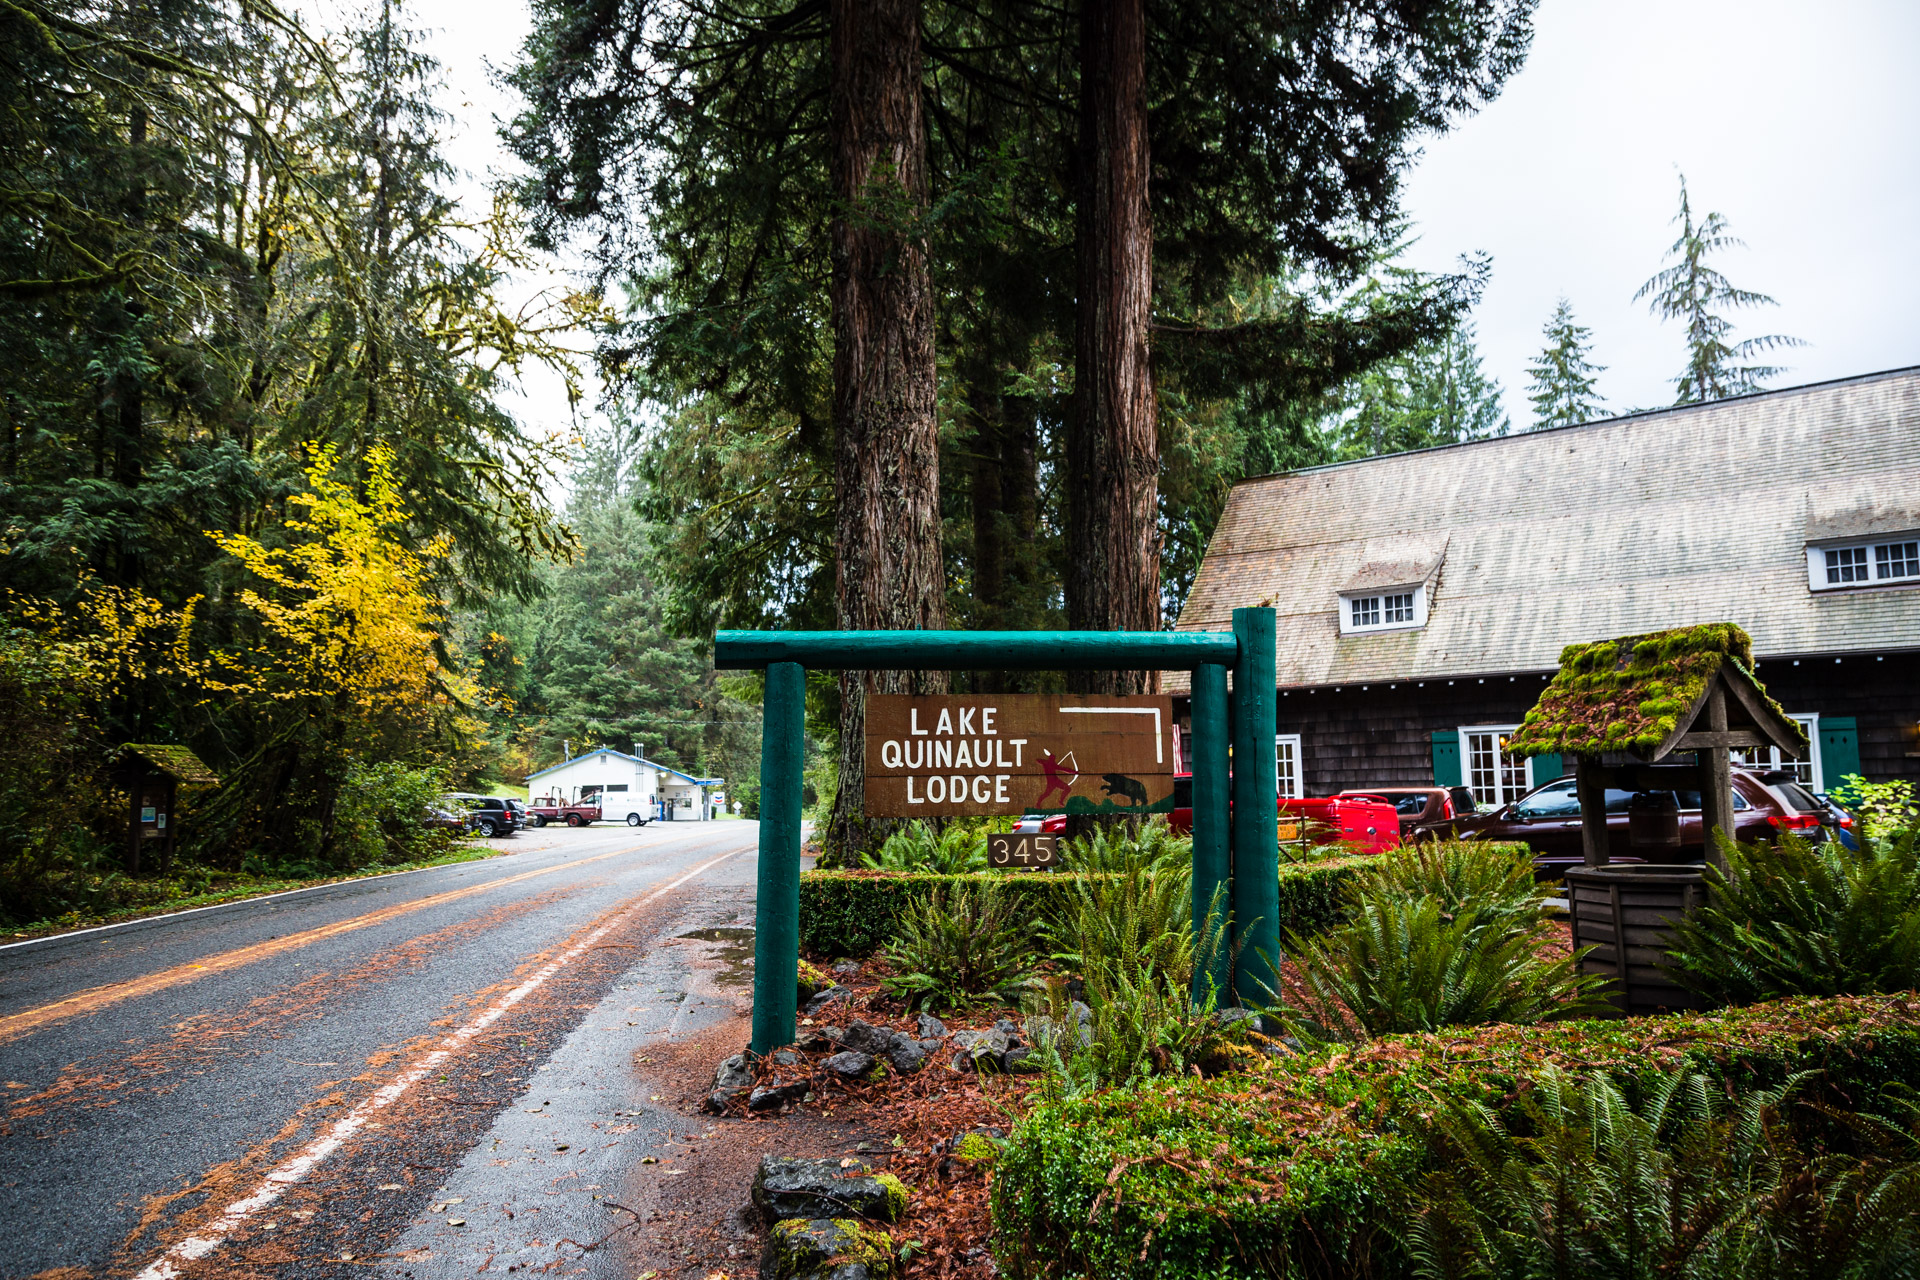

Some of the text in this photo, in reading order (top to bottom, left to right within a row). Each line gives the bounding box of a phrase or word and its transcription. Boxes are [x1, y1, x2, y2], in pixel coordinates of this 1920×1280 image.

[911, 706, 998, 736] LAKE
[881, 738, 1028, 769] QUINAULT
[907, 774, 1011, 804] LODGE
[993, 836, 1053, 864] 345
